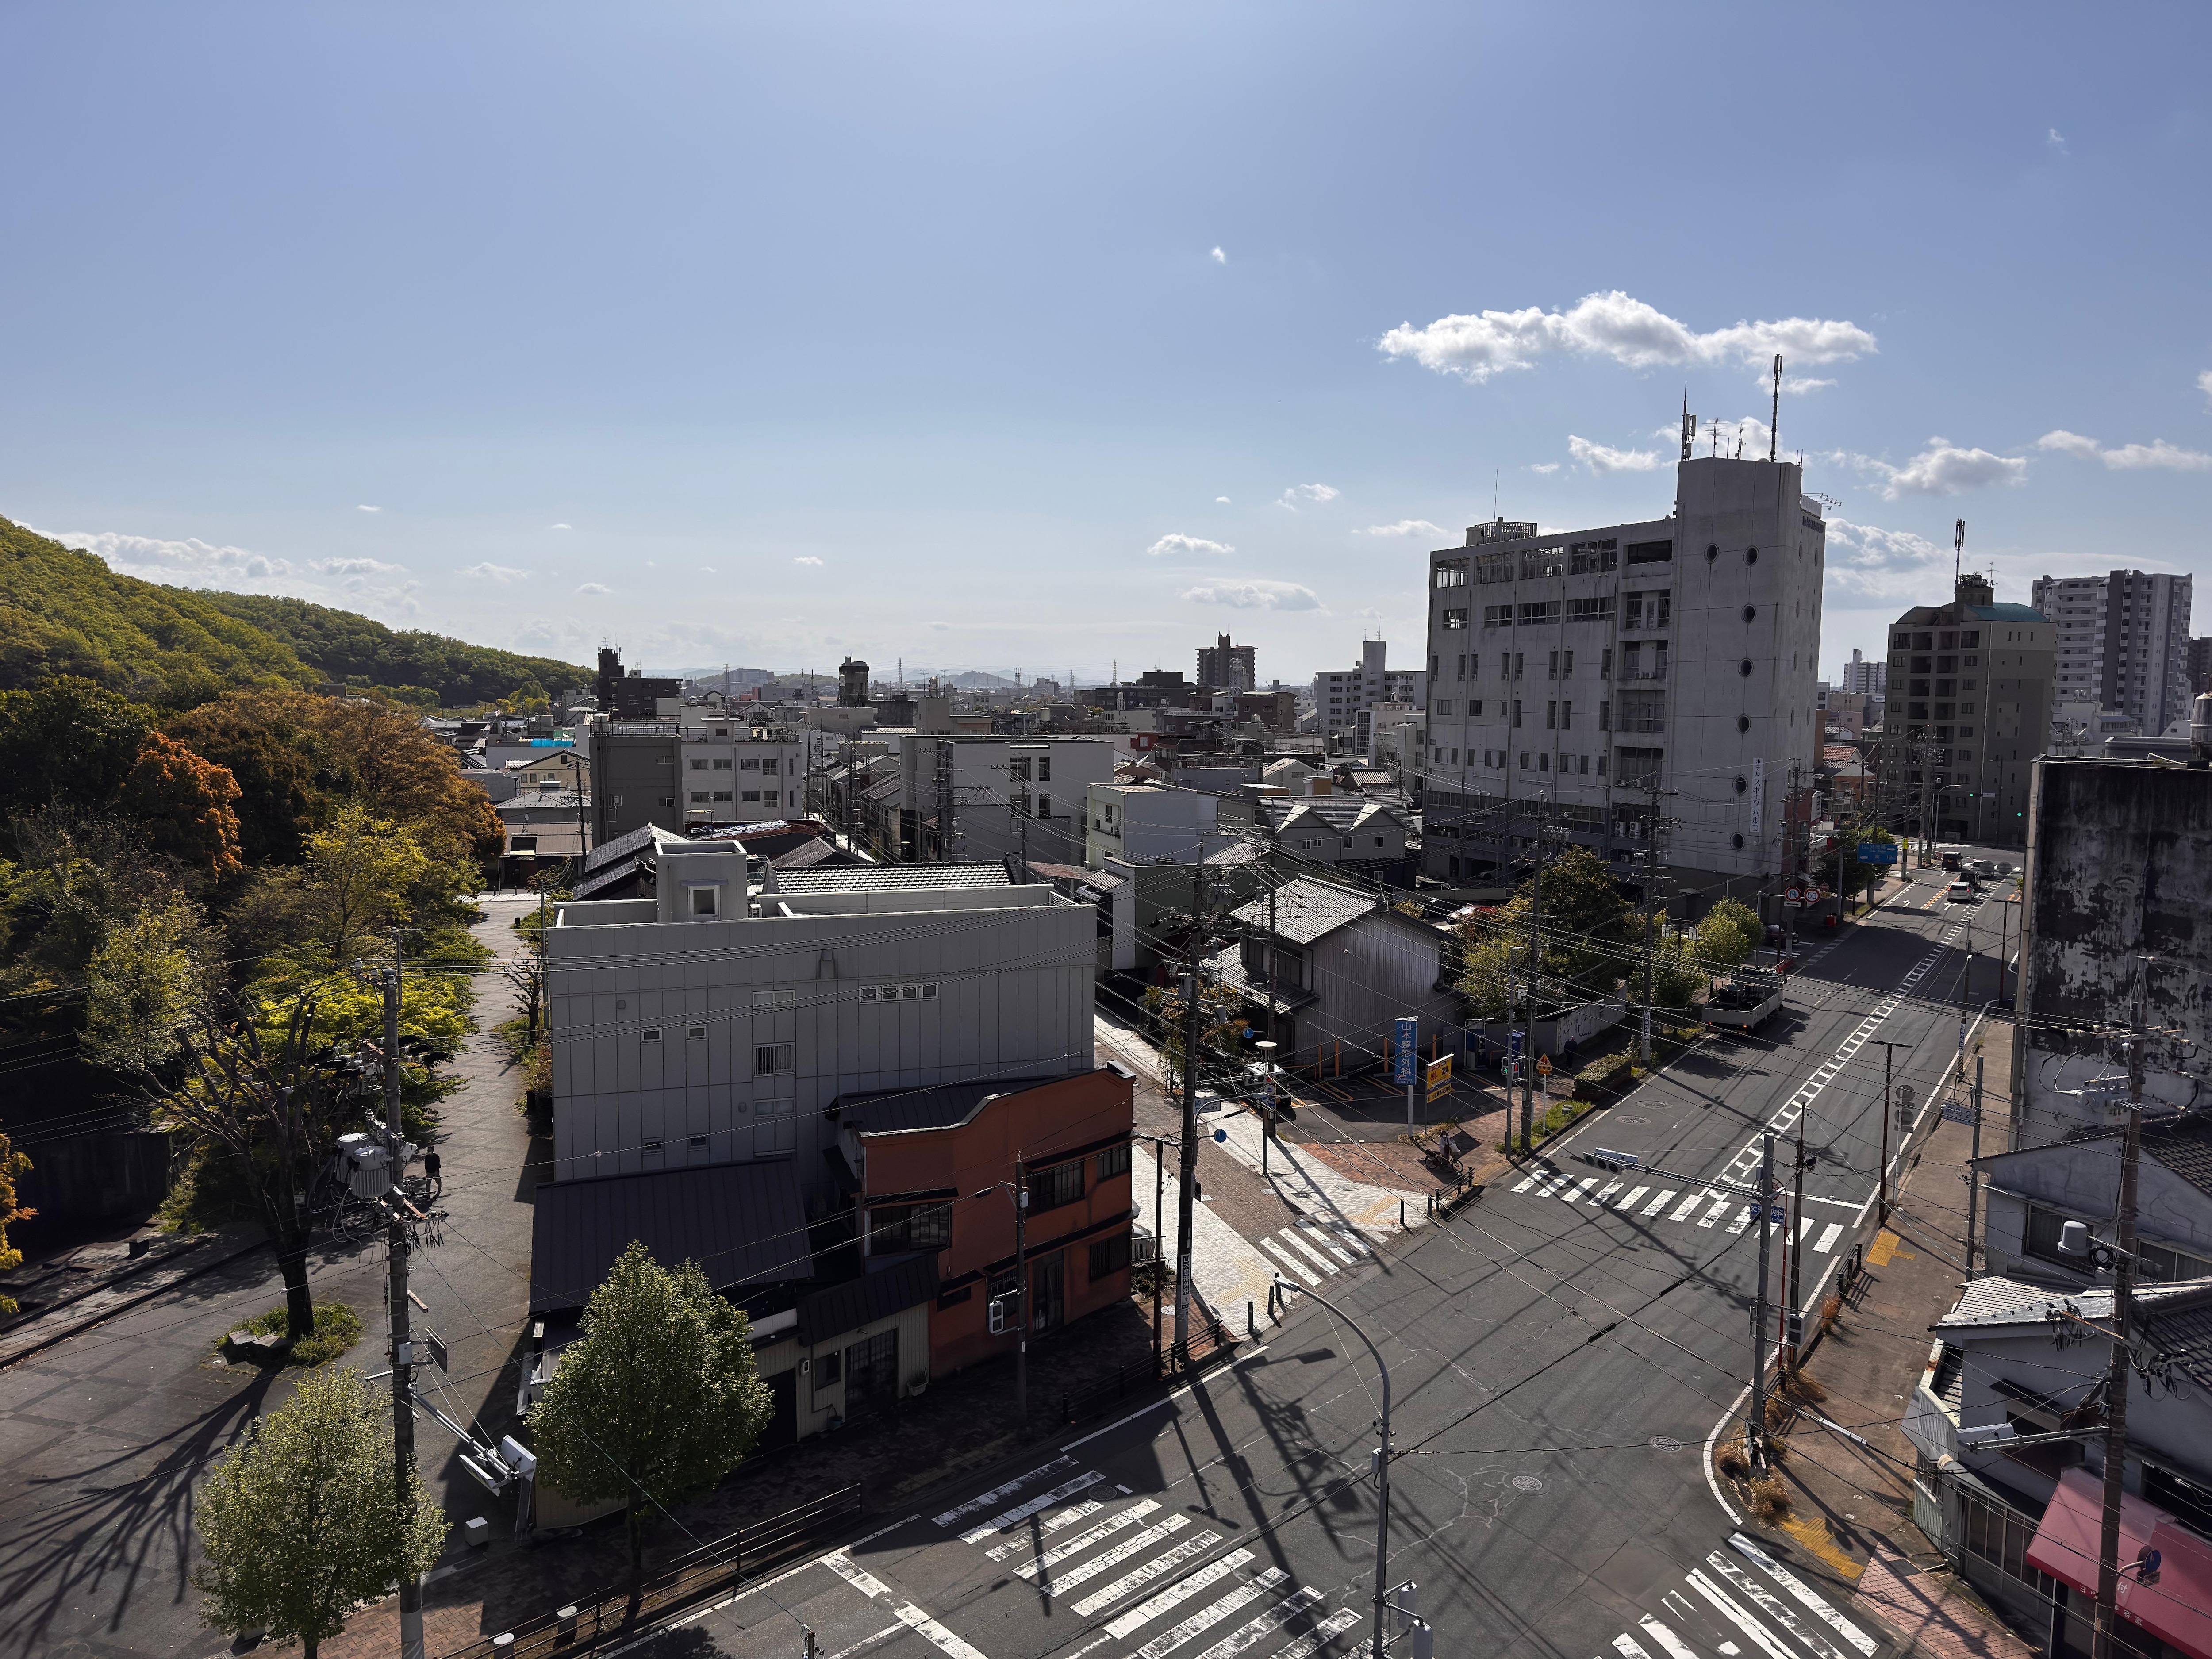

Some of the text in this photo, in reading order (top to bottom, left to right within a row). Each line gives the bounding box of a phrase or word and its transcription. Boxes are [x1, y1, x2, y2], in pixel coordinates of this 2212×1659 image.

[1517, 988, 1527, 1000] P
[1401, 1022, 1411, 1076] 山本整形外科
